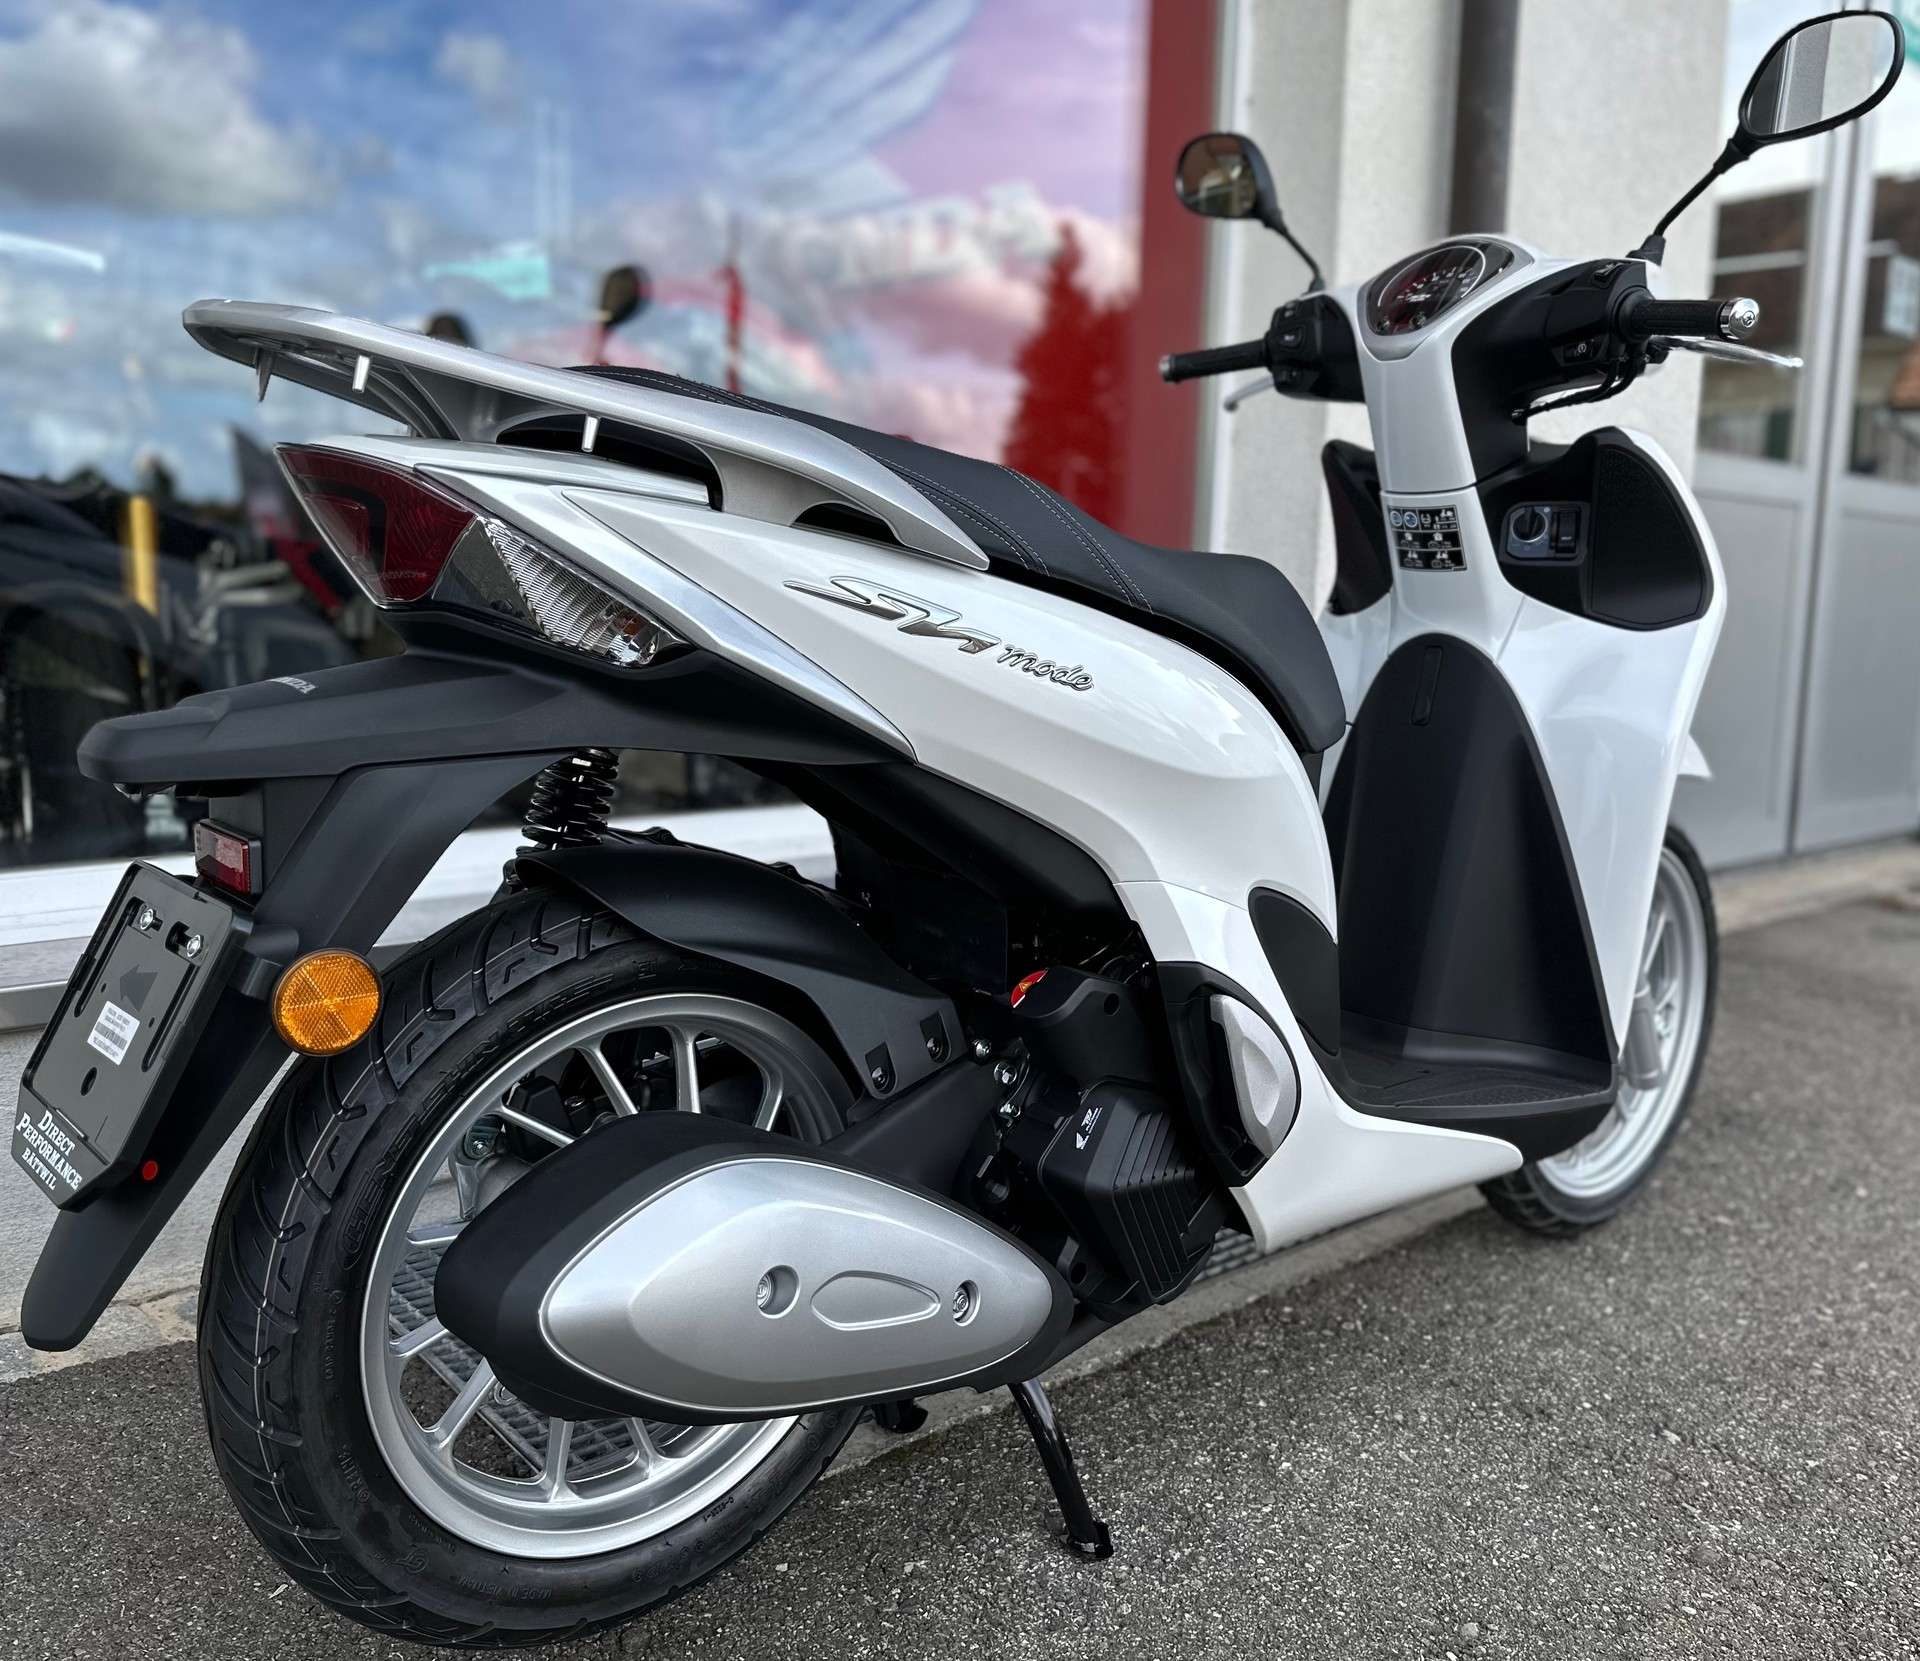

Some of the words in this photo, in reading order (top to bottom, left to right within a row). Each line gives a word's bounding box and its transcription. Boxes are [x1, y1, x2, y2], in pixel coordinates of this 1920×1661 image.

[997, 643, 1095, 693] mode
[15, 1112, 83, 1191] PERFORMANCE
[37, 1109, 76, 1157] DIRECT
[21, 1147, 57, 1191] BÄTTWIL
